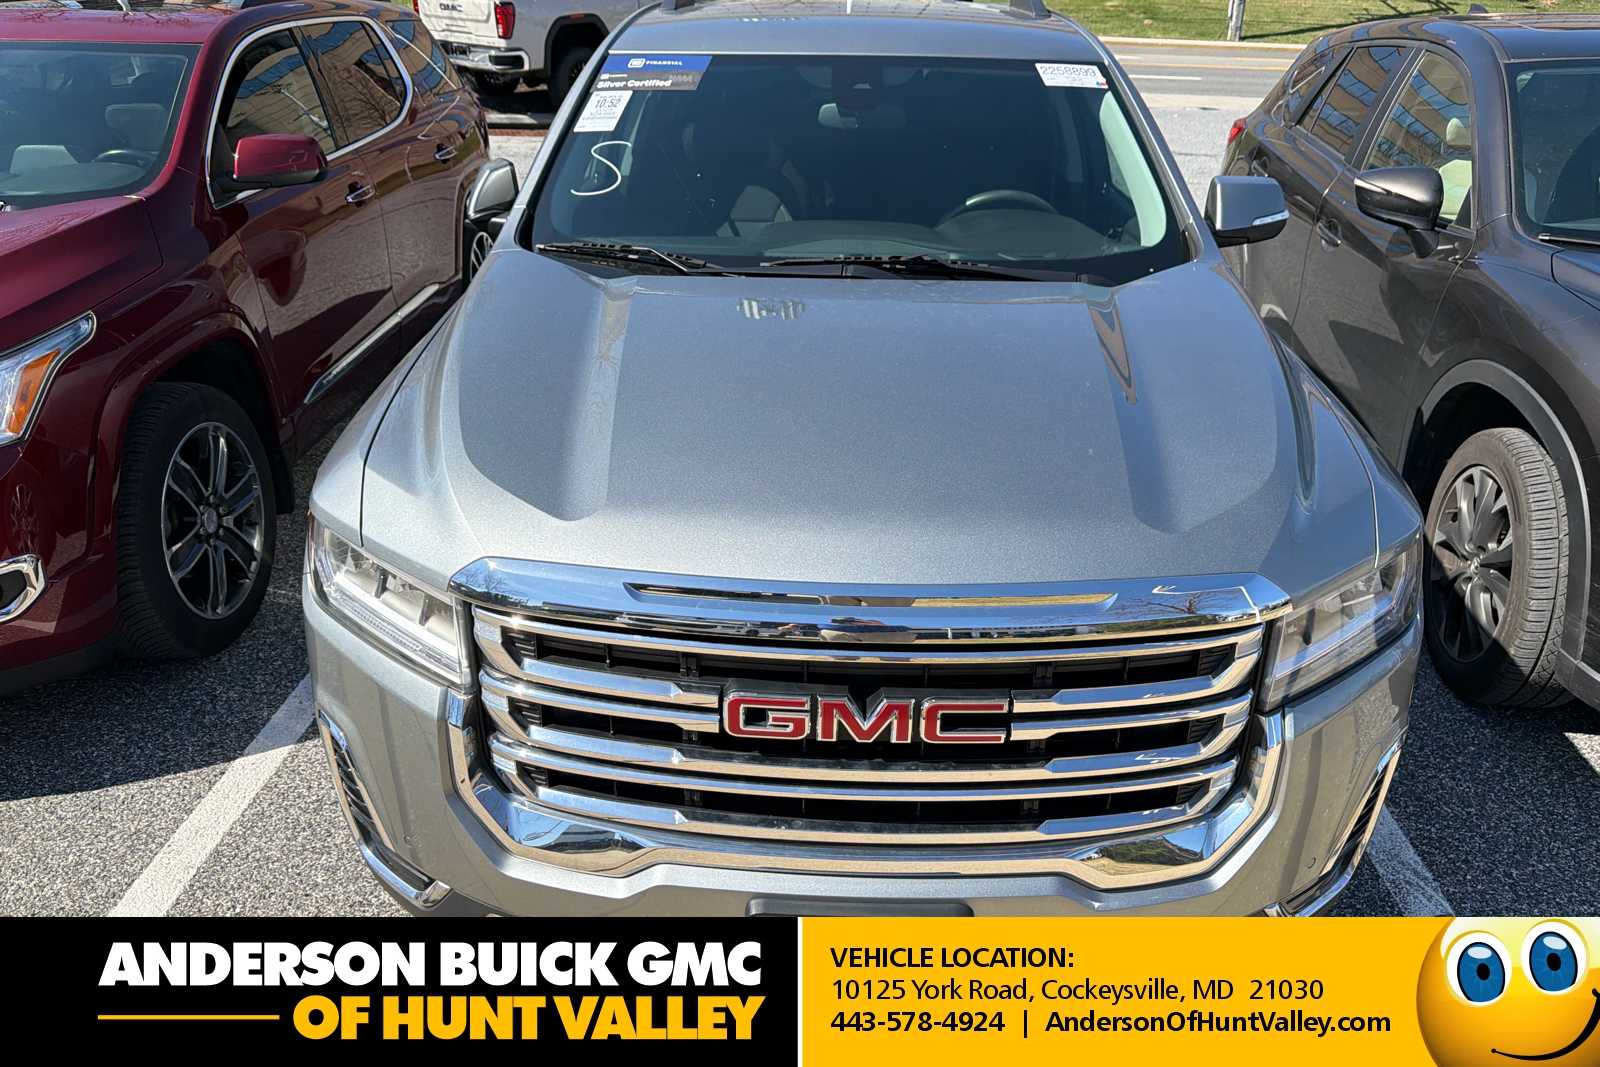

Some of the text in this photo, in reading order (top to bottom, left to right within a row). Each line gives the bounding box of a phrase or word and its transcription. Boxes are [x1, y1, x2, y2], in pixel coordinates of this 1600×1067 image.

[597, 79, 672, 89] Silver Certified
[723, 692, 1011, 744] GMC
